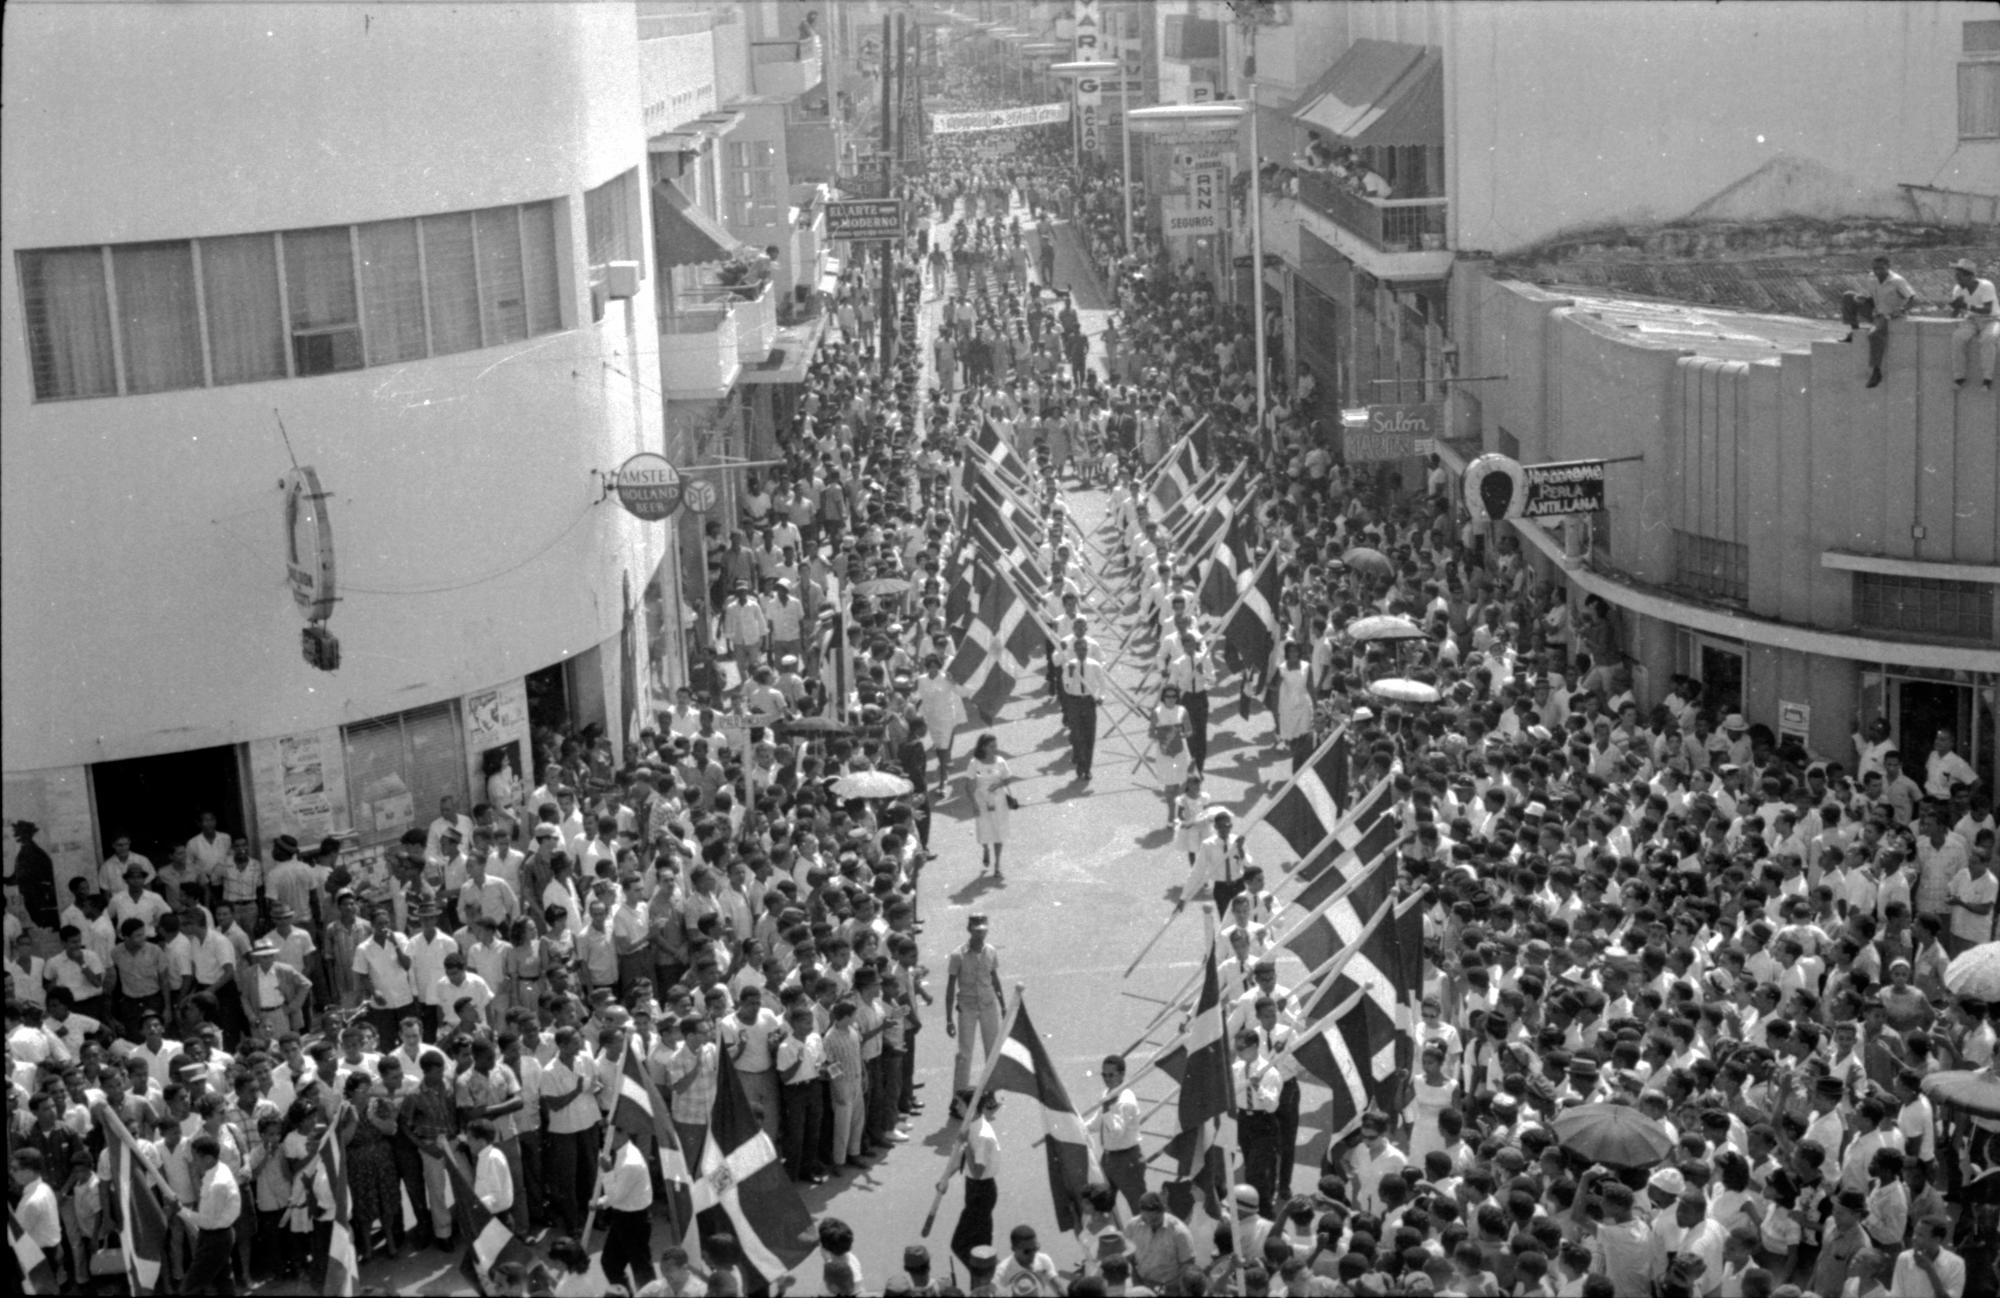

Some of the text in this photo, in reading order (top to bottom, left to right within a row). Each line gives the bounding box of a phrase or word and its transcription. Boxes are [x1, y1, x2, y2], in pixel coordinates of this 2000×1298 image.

[848, 204, 878, 216] ARTE
[840, 216, 897, 228] MODERNO
[1170, 216, 1214, 230] SEGUROS
[1373, 410, 1430, 433] Salón
[621, 469, 676, 483] AMSTEL
[622, 487, 679, 501] HOLLAND
[635, 502, 666, 513] BEER
[1525, 496, 1600, 515] ANTILLANA
